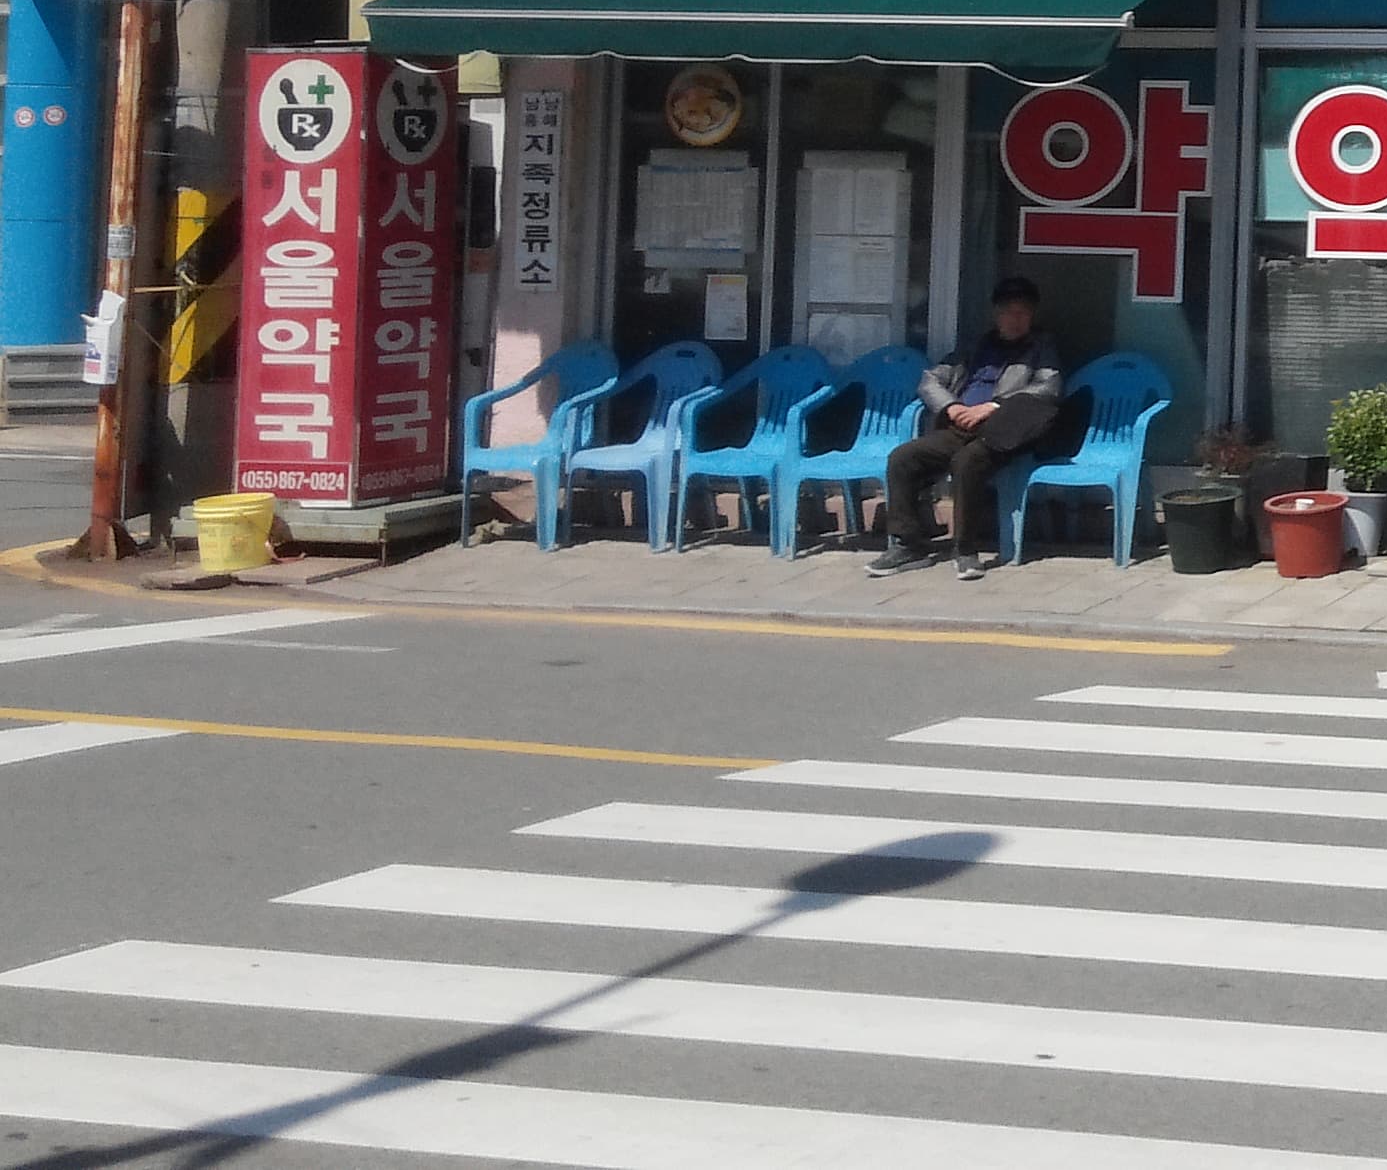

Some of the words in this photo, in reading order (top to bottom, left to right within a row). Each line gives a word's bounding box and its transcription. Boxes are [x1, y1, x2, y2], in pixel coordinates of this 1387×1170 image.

[521, 133, 555, 285] 지족정류소
[1001, 80, 1212, 303] 약
[255, 168, 340, 459] 서울약국
[371, 170, 437, 454] 서울약국
[242, 470, 345, 491] (055)867-0824
